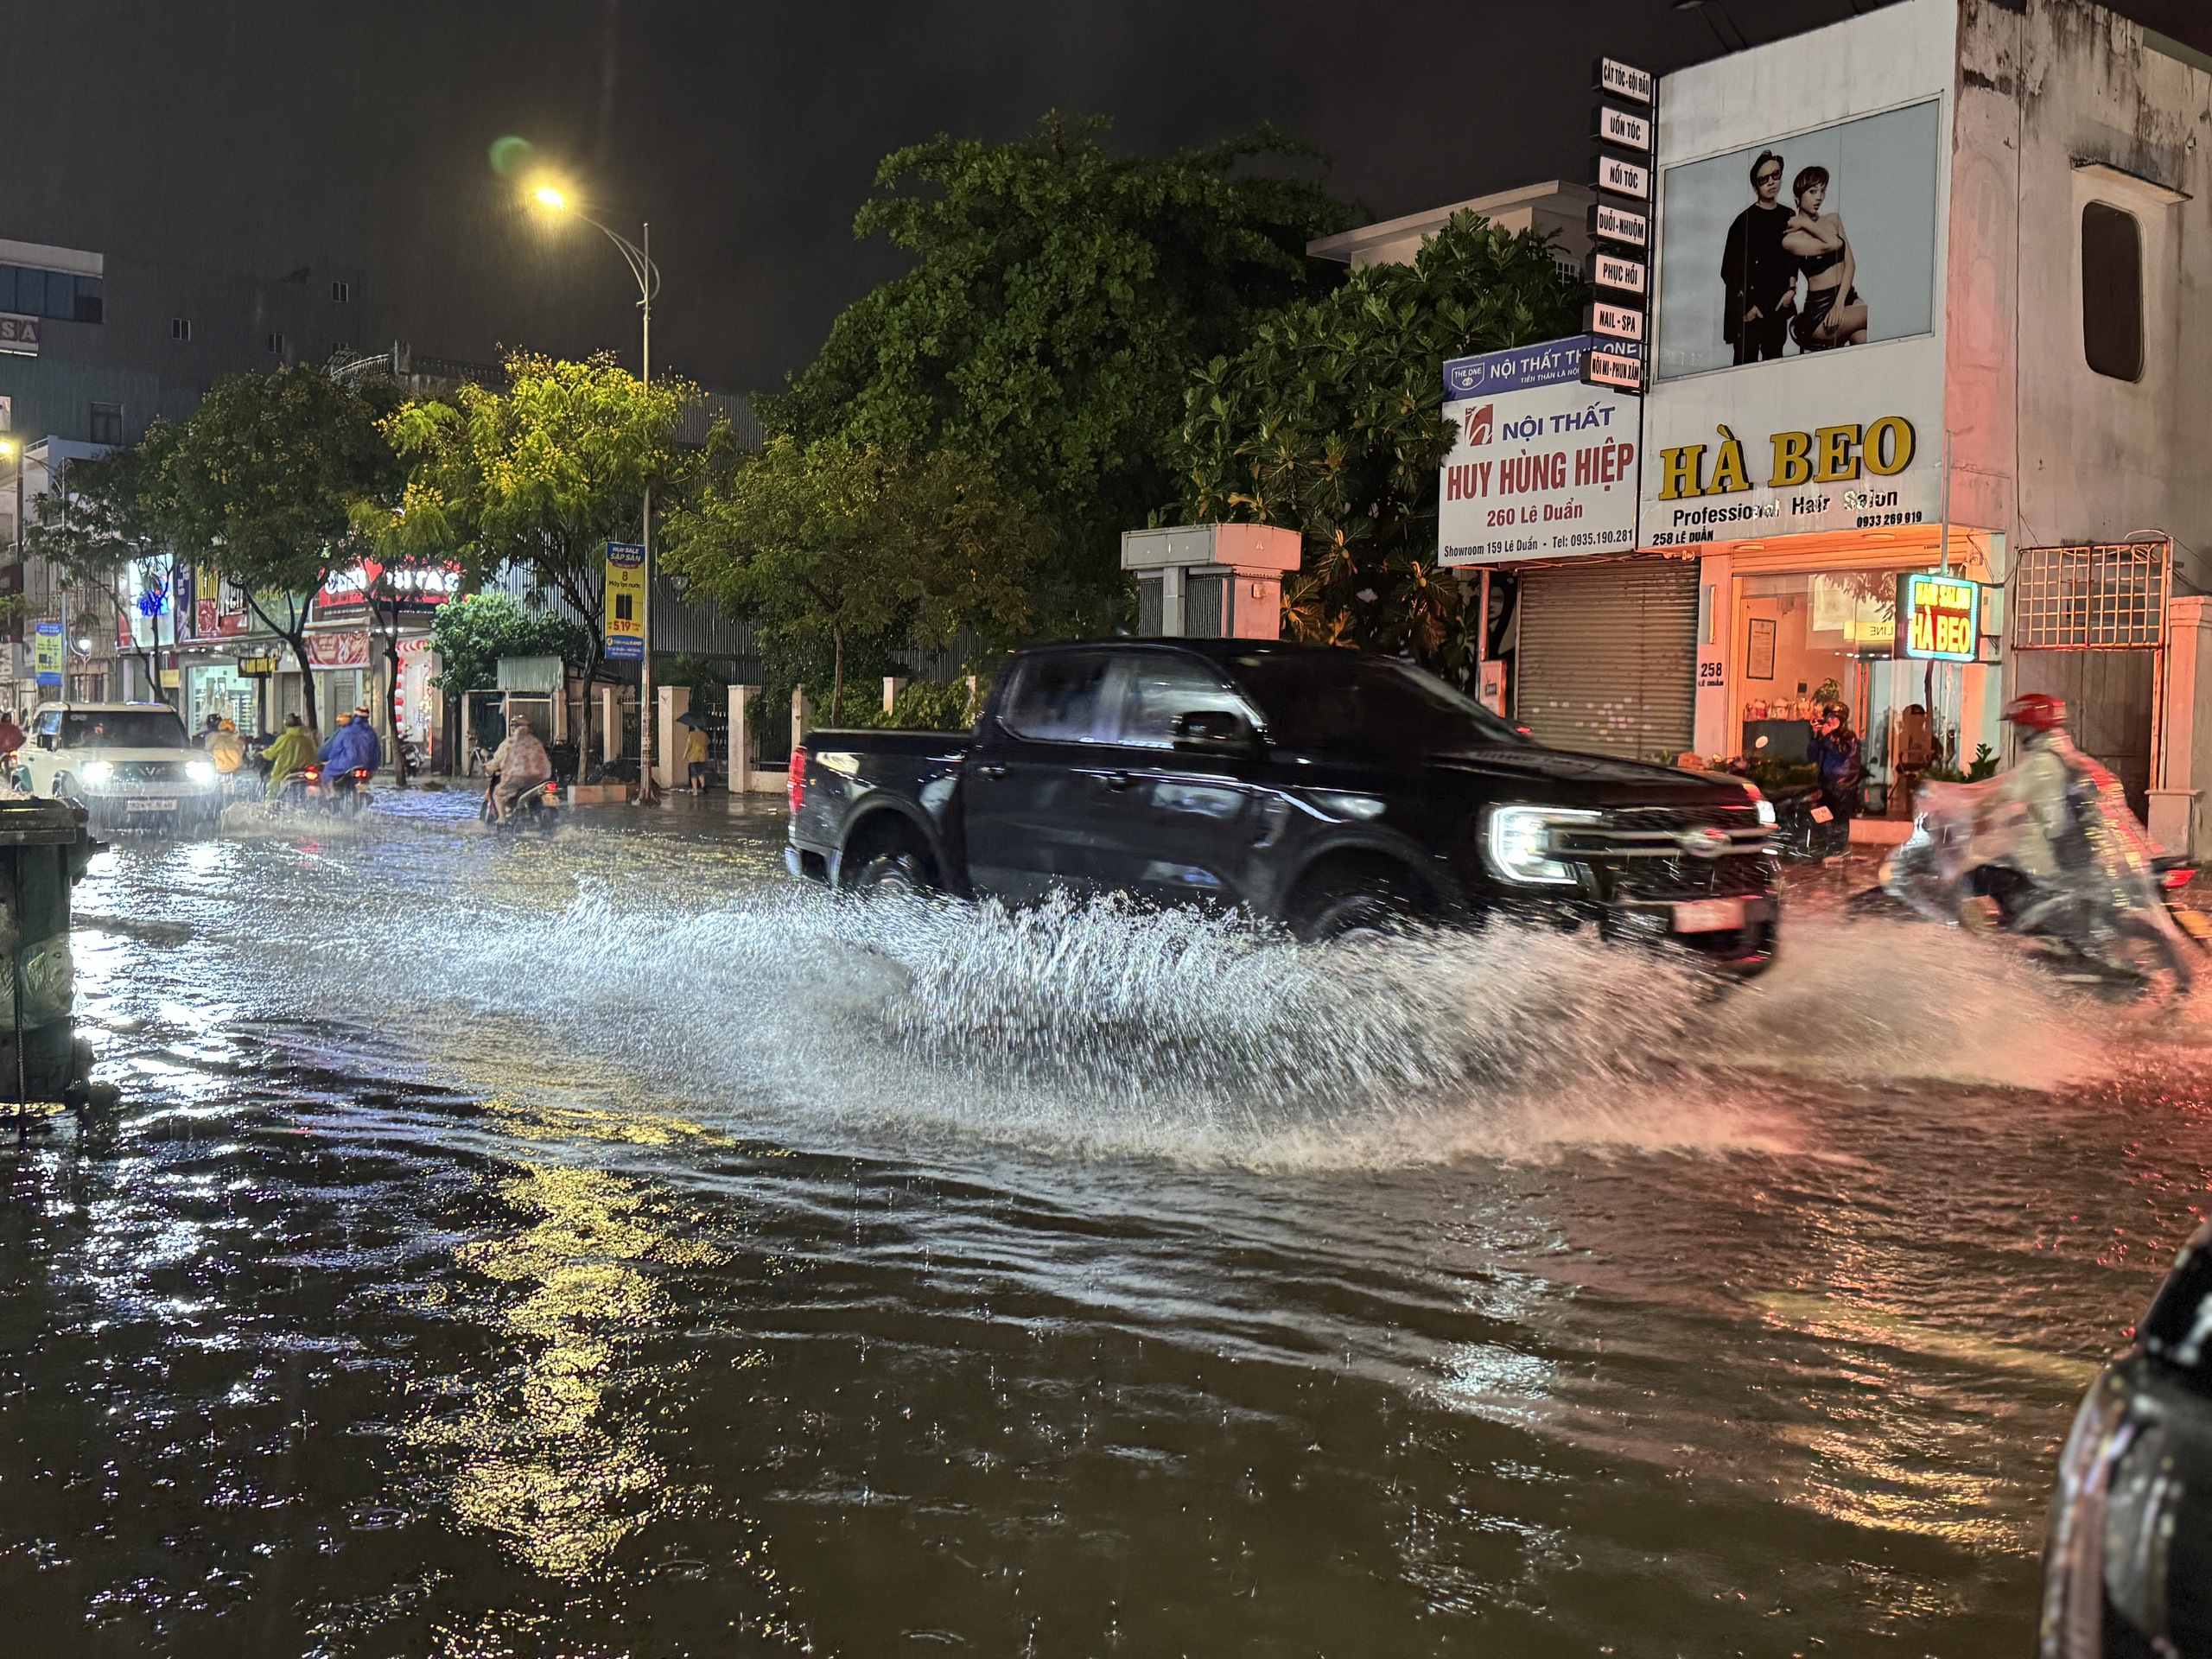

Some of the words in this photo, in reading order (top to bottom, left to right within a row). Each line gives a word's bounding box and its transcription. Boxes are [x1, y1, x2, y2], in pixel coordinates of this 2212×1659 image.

[1615, 67, 1625, 87] TÓC
[1611, 114, 1625, 137] UỐN
[1627, 120, 1641, 141] TÓC
[1610, 163, 1622, 185] NỐI
[1624, 168, 1638, 189] TÓC
[1619, 218, 1643, 240] NHUỘM
[1603, 262, 1624, 283] PHỤC
[1599, 309, 1616, 328] NAIL
[1622, 315, 1636, 333] SPA
[1454, 370, 1467, 378] THE
[1468, 367, 1482, 377] ONE
[1491, 361, 1516, 380] NỘI
[1521, 349, 1561, 372] THẤT
[1611, 361, 1627, 378] PHUN
[1503, 415, 1542, 442] NỘI
[1550, 402, 1616, 433] THẤT
[1447, 461, 1492, 501] HUY
[1500, 448, 1566, 495] HÙNG
[1575, 436, 1634, 492] HIỆP
[1658, 423, 1753, 501] HÀ
[1768, 416, 1916, 488] BEO
[1487, 507, 1515, 527] 260
[1521, 505, 1537, 524] Lê
[1543, 497, 1583, 522] Duẩn
[1674, 498, 1780, 527] Professional
[1792, 496, 1831, 516] Hair
[1844, 489, 1898, 511] Salon
[1857, 514, 1881, 528] 0933
[1885, 512, 1902, 525] 269
[1904, 511, 1923, 524] 919
[1444, 544, 1484, 557] Showroom
[1487, 541, 1502, 555] 159
[1504, 539, 1514, 552] Lê
[1553, 535, 1568, 549] Tel:
[1571, 529, 1633, 547] 0935.190.281
[1653, 532, 1673, 546] 258
[1675, 530, 1686, 544] LÊ
[1689, 524, 1713, 543] DUẨN
[621, 571, 628, 582] 8
[1911, 606, 1935, 651] HÀ
[1936, 614, 1971, 654] BEO
[1700, 662, 1722, 677] 258
